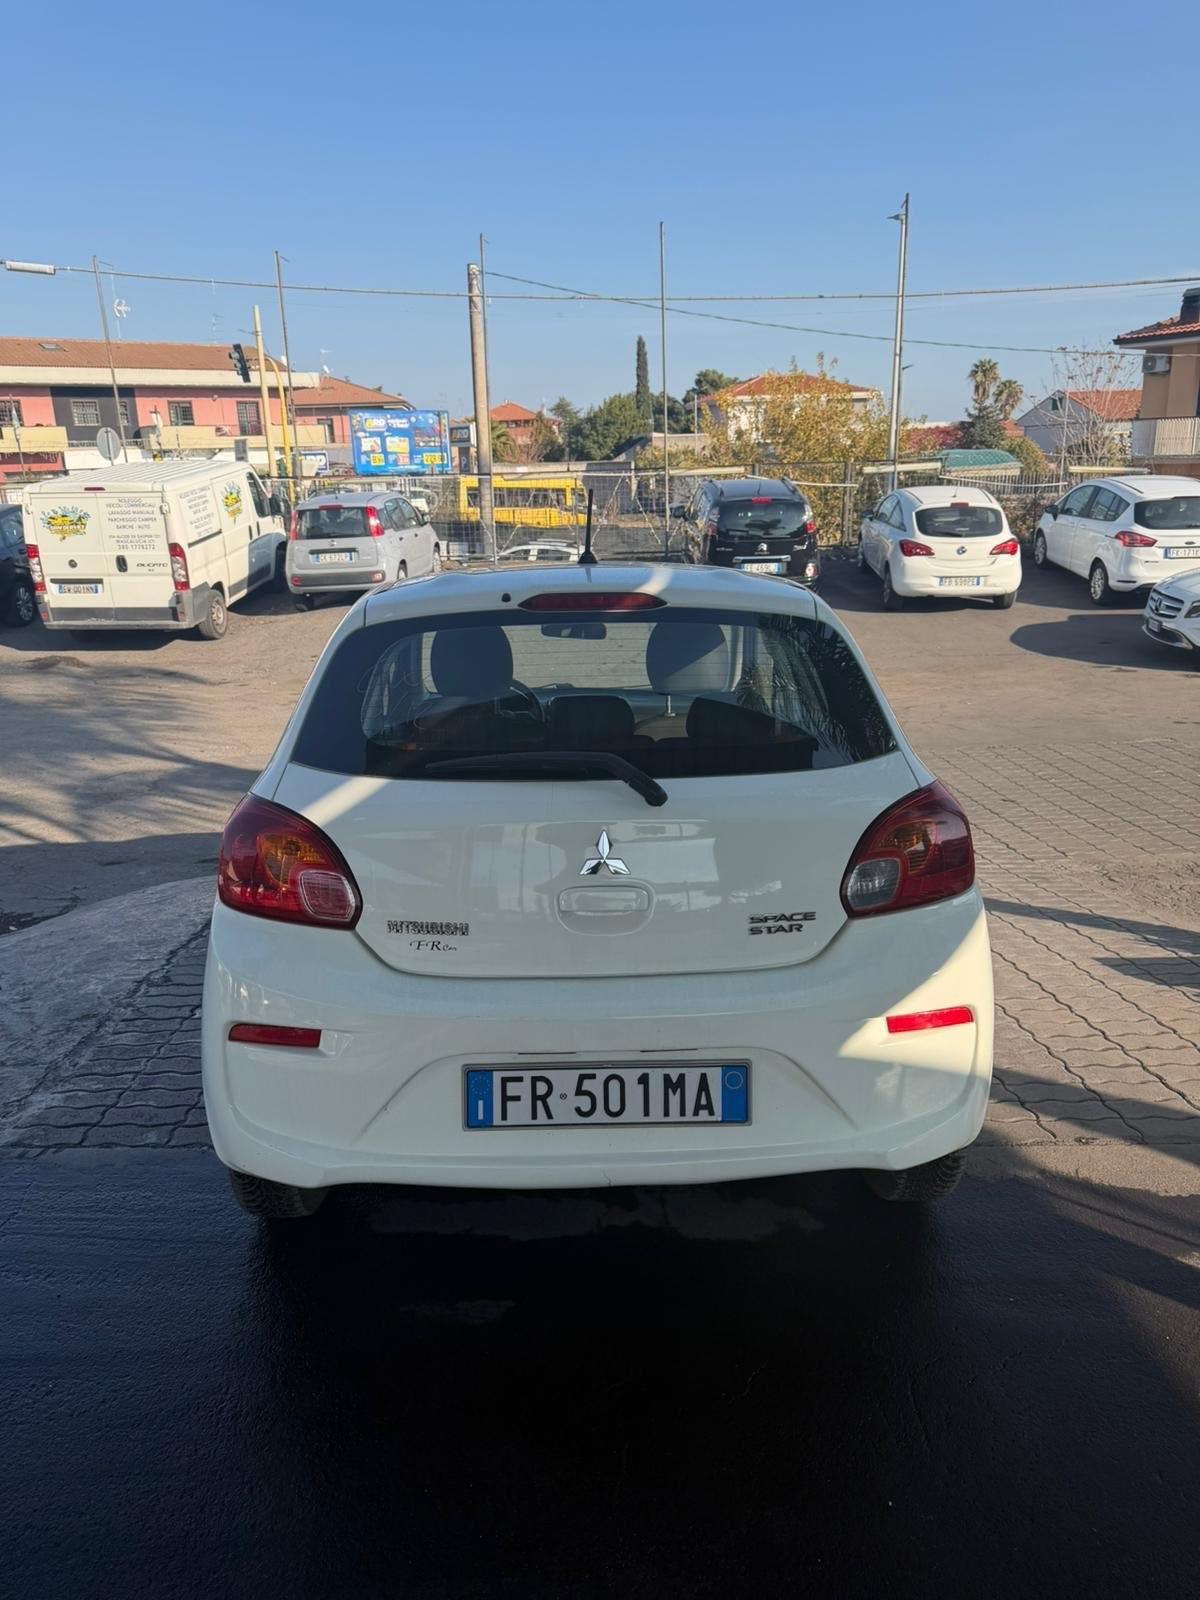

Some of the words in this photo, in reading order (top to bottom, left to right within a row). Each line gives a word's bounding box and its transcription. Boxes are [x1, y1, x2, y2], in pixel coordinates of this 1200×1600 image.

[749, 911, 817, 924] SPACE
[387, 920, 469, 936] MITSUBISHI
[749, 923, 803, 935] STAR
[500, 1075, 554, 1121] FR
[574, 1072, 715, 1119] 501MA
